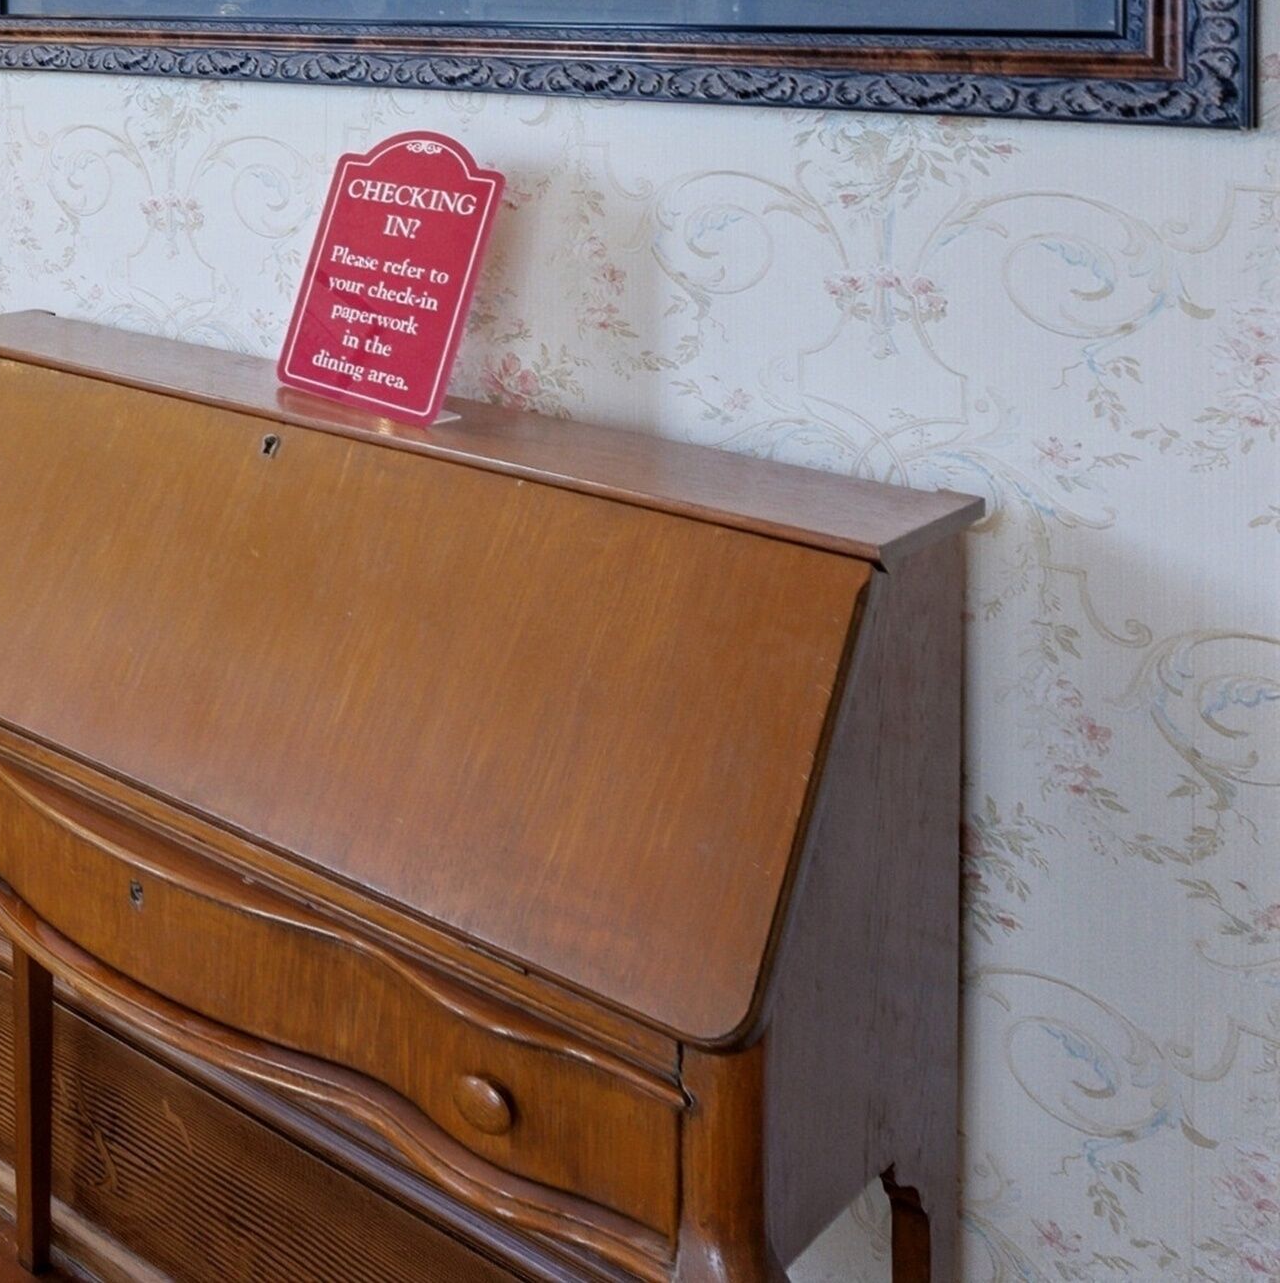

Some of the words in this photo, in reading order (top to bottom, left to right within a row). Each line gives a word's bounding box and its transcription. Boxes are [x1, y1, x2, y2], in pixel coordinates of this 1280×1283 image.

[348, 178, 477, 216] CHECKING
[382, 214, 421, 239] IN?
[330, 245, 378, 271] Please
[383, 256, 425, 280] refer
[430, 268, 449, 285] to
[328, 276, 364, 296] your
[368, 284, 438, 312] check-in
[331, 304, 419, 336] paperwork
[342, 330, 359, 349] in
[364, 333, 392, 357] the
[312, 350, 364, 382] dining
[368, 366, 410, 391] area.
